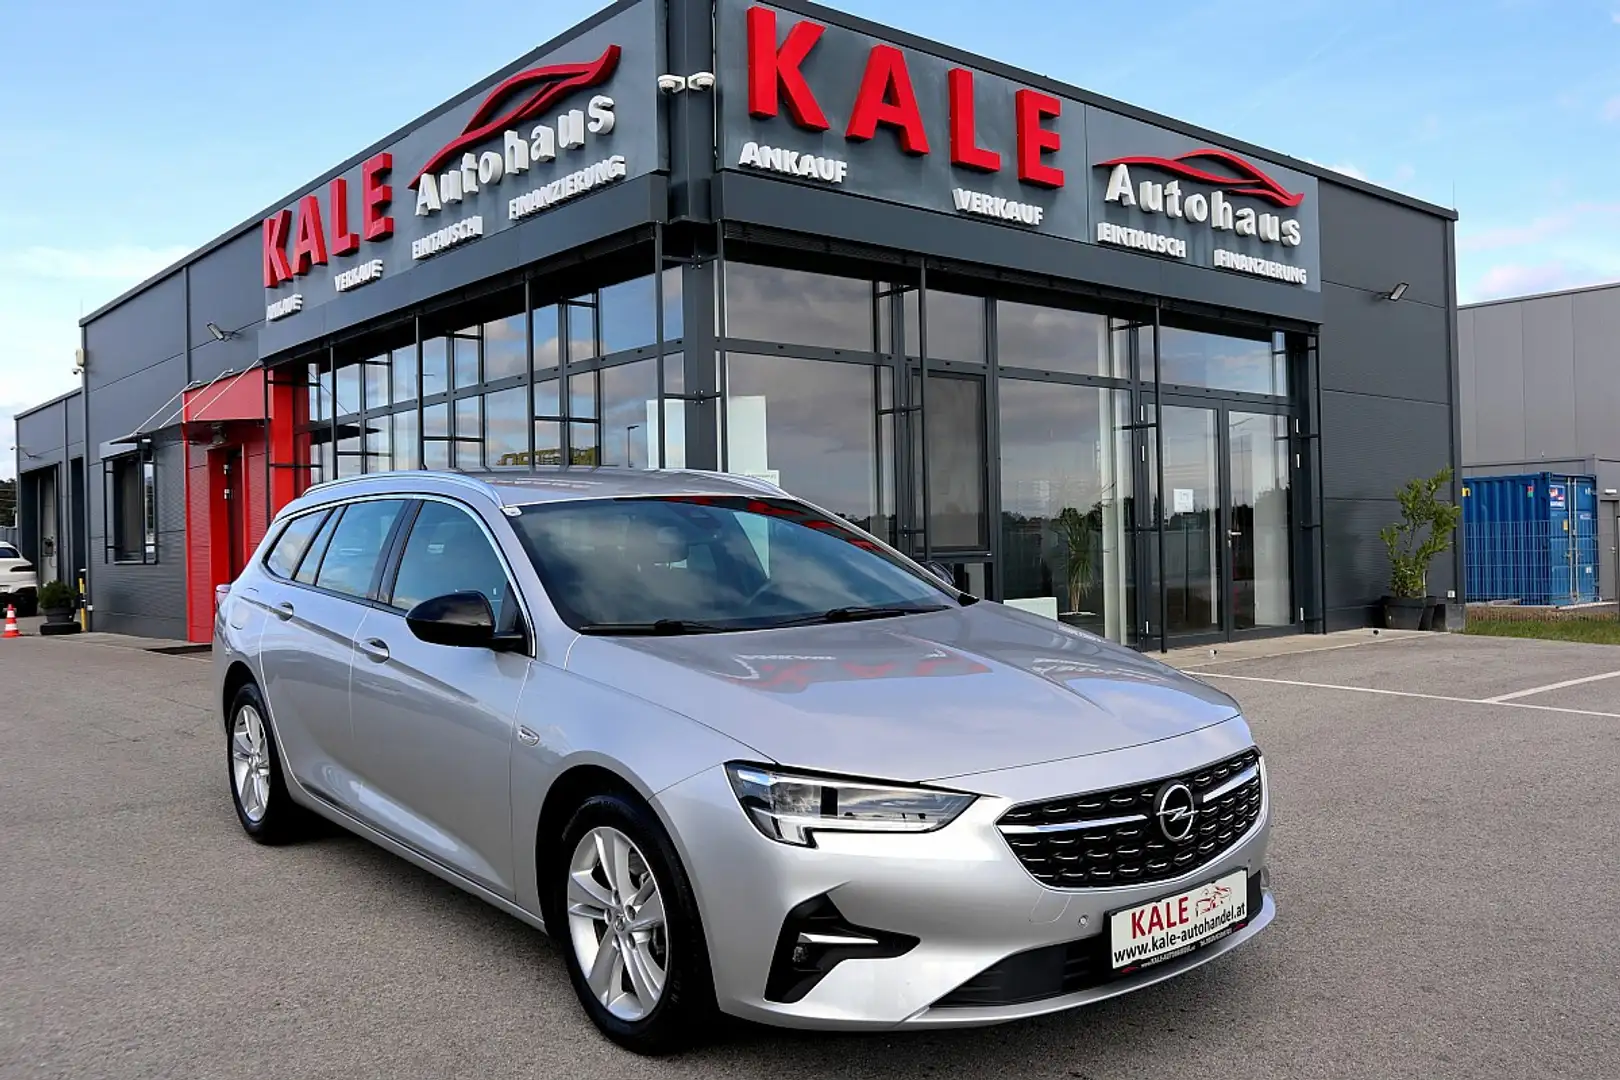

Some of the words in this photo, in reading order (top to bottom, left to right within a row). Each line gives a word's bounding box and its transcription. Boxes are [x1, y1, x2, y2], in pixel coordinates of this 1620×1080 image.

[747, 6, 1064, 189] KALE
[415, 95, 615, 216] Autohaus
[738, 141, 847, 184] ANKAUF
[508, 155, 627, 220] FINANZIERUNG
[952, 188, 1043, 226] VERKAUF
[1104, 164, 1301, 247] Autohaus
[262, 152, 394, 288] KALE
[411, 216, 484, 260] EINTAUSCH
[1097, 222, 1187, 258] EINTAUSCH
[1213, 249, 1307, 285] FINANZIERUNG
[1113, 902, 1246, 963] www.kale-autohandel.at
[1131, 896, 1190, 940] KALE
